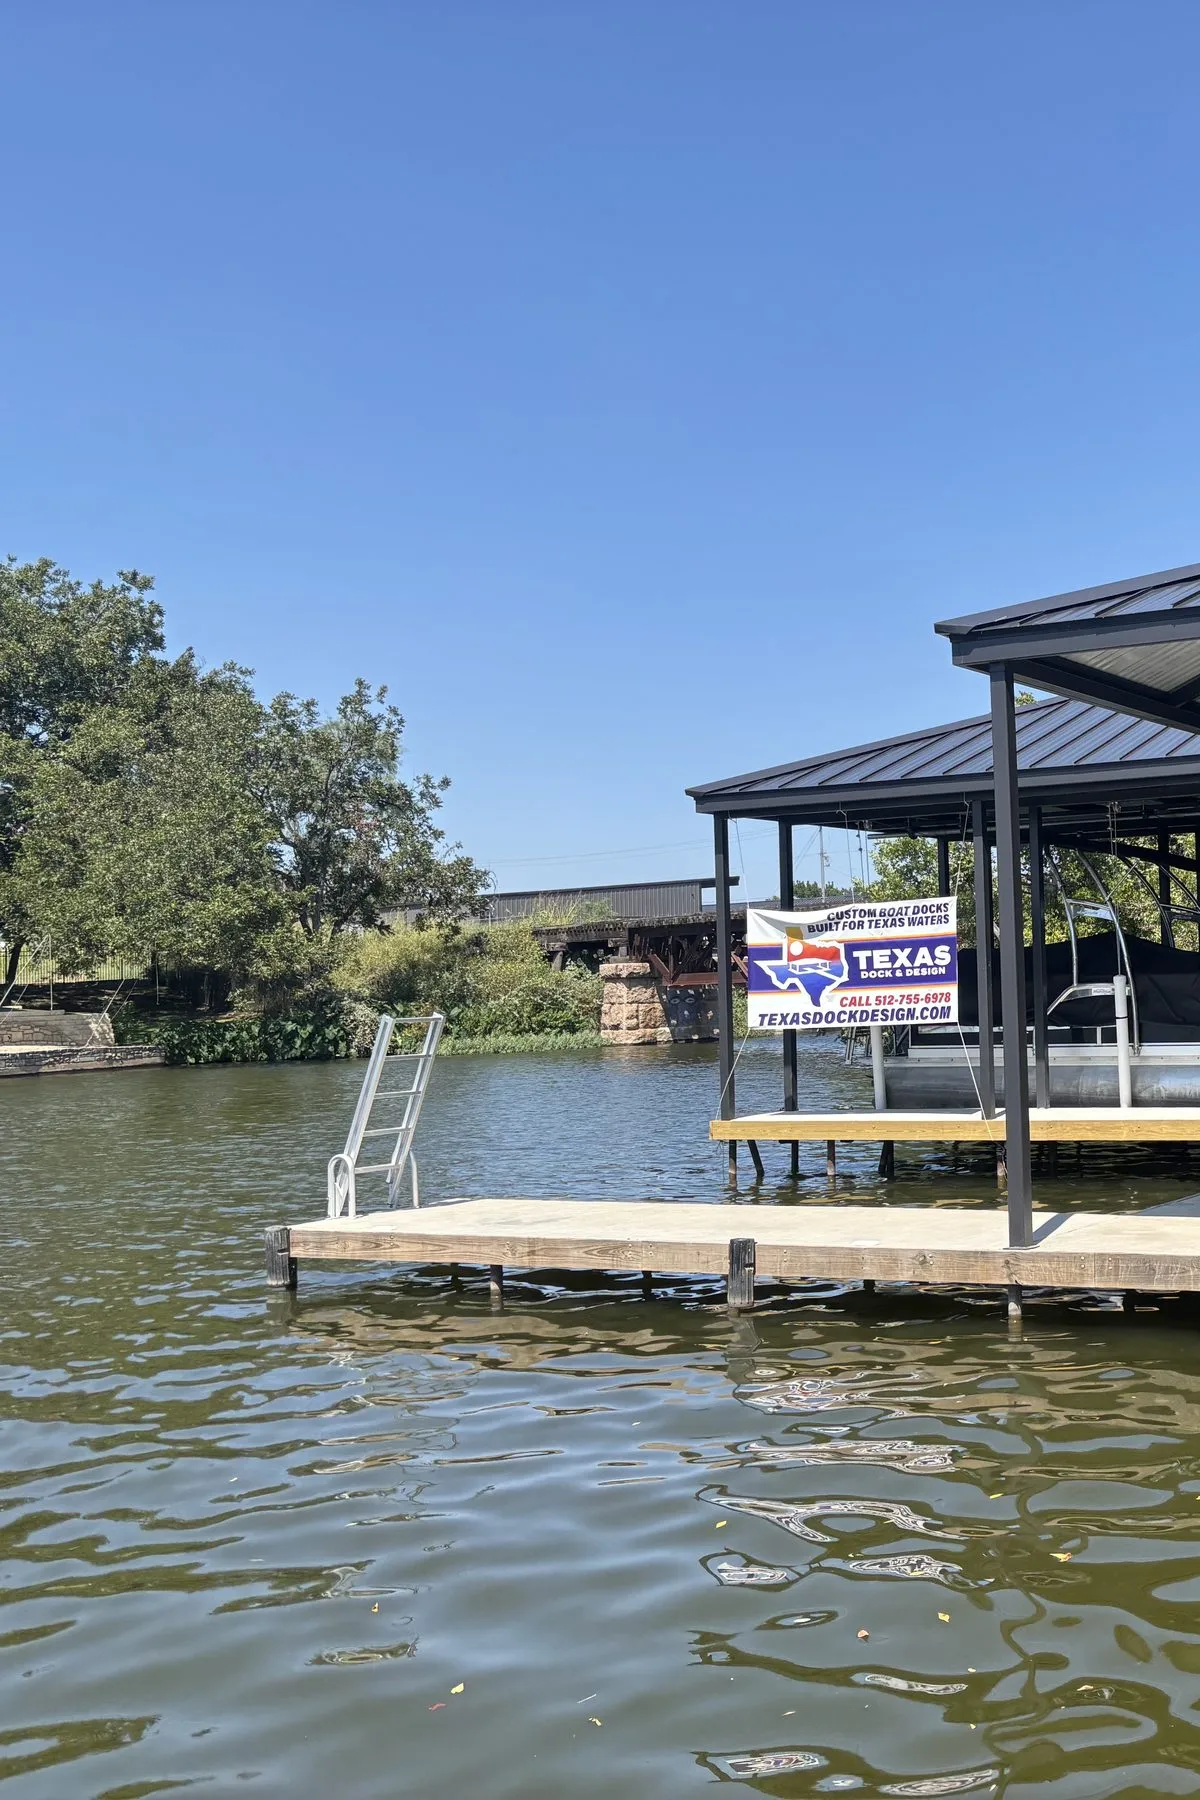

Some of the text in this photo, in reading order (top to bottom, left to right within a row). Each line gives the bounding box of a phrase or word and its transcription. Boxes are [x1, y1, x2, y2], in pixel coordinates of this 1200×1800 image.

[827, 902, 950, 922] CUSTOM BOAT DOCKS
[807, 914, 950, 933] BUILT FOR TEXAS WATERS
[853, 945, 951, 970] TEXAS
[860, 966, 946, 979] DOCK & DESIGN
[839, 992, 951, 1008] CALL 512-755-6978
[758, 1006, 951, 1027] TEXASDOCKDESIGN.COM
